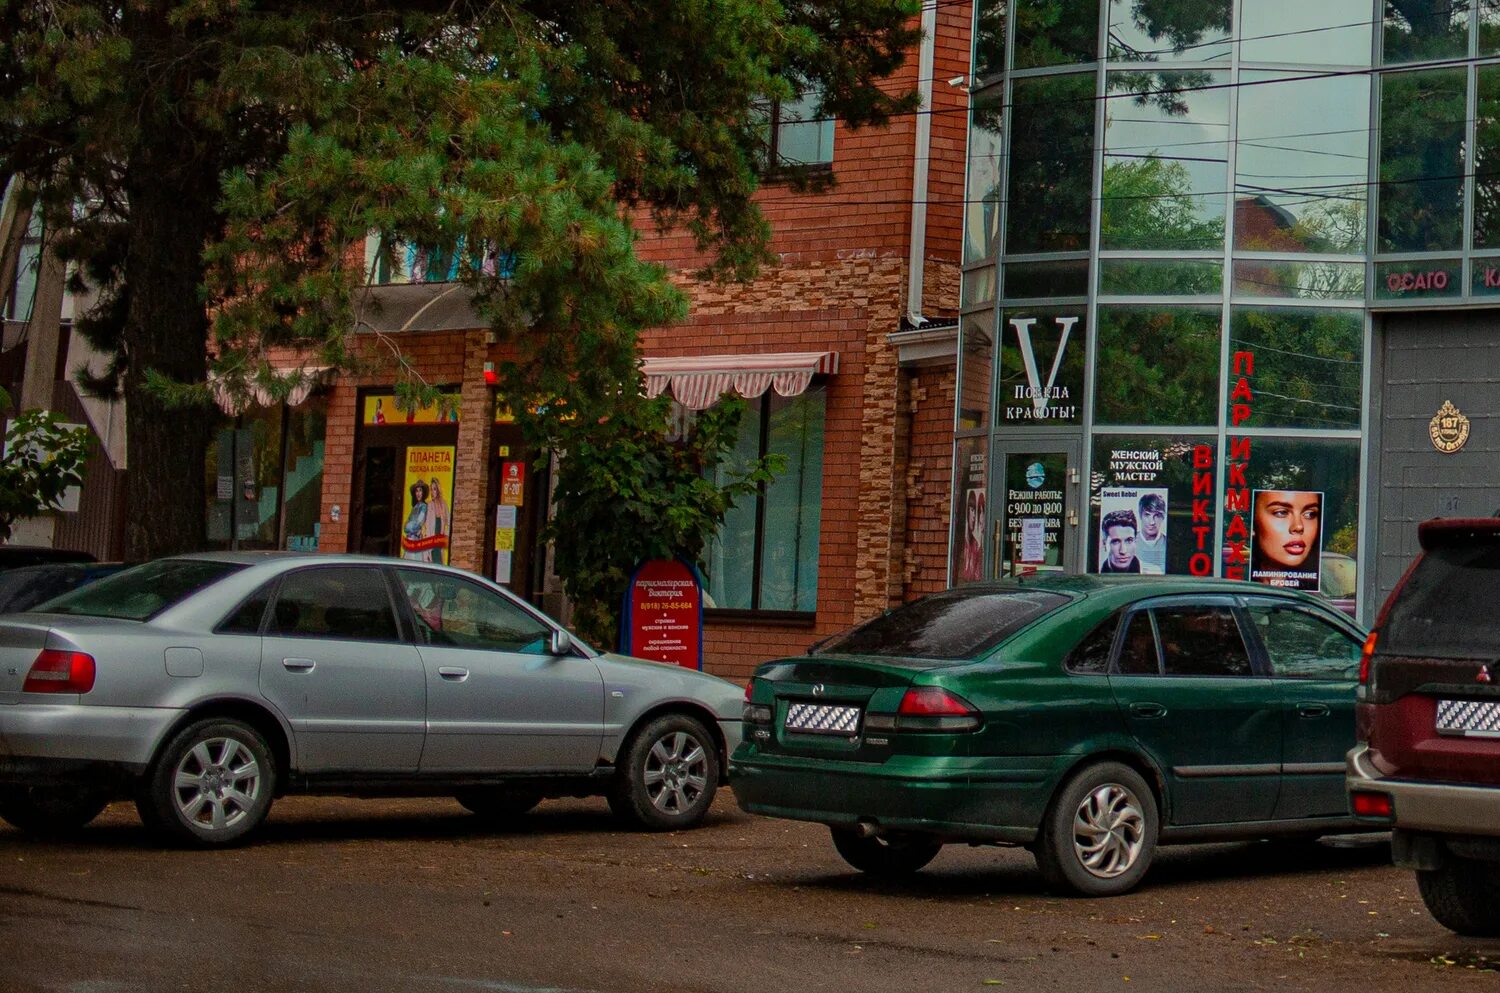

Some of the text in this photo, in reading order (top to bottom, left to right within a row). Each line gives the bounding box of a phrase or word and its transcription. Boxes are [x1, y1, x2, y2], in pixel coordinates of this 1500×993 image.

[1386, 270, 1448, 292] ОСАГО
[1008, 316, 1079, 419] V
[1006, 406, 1076, 419] КРАСОТЫ!
[1440, 418, 1459, 428] 187
[410, 451, 450, 463] ПЛАНЕТА
[1111, 450, 1159, 460] ЖЕНСКИЙ
[1110, 460, 1164, 470] МУЖСКОЙ
[1114, 472, 1156, 481] МАСТЕР
[1103, 490, 1138, 498] Sweet Rebel
[1014, 503, 1031, 514] 9.00
[1252, 570, 1318, 579] ЛАМИНИРОВАНИЕ
